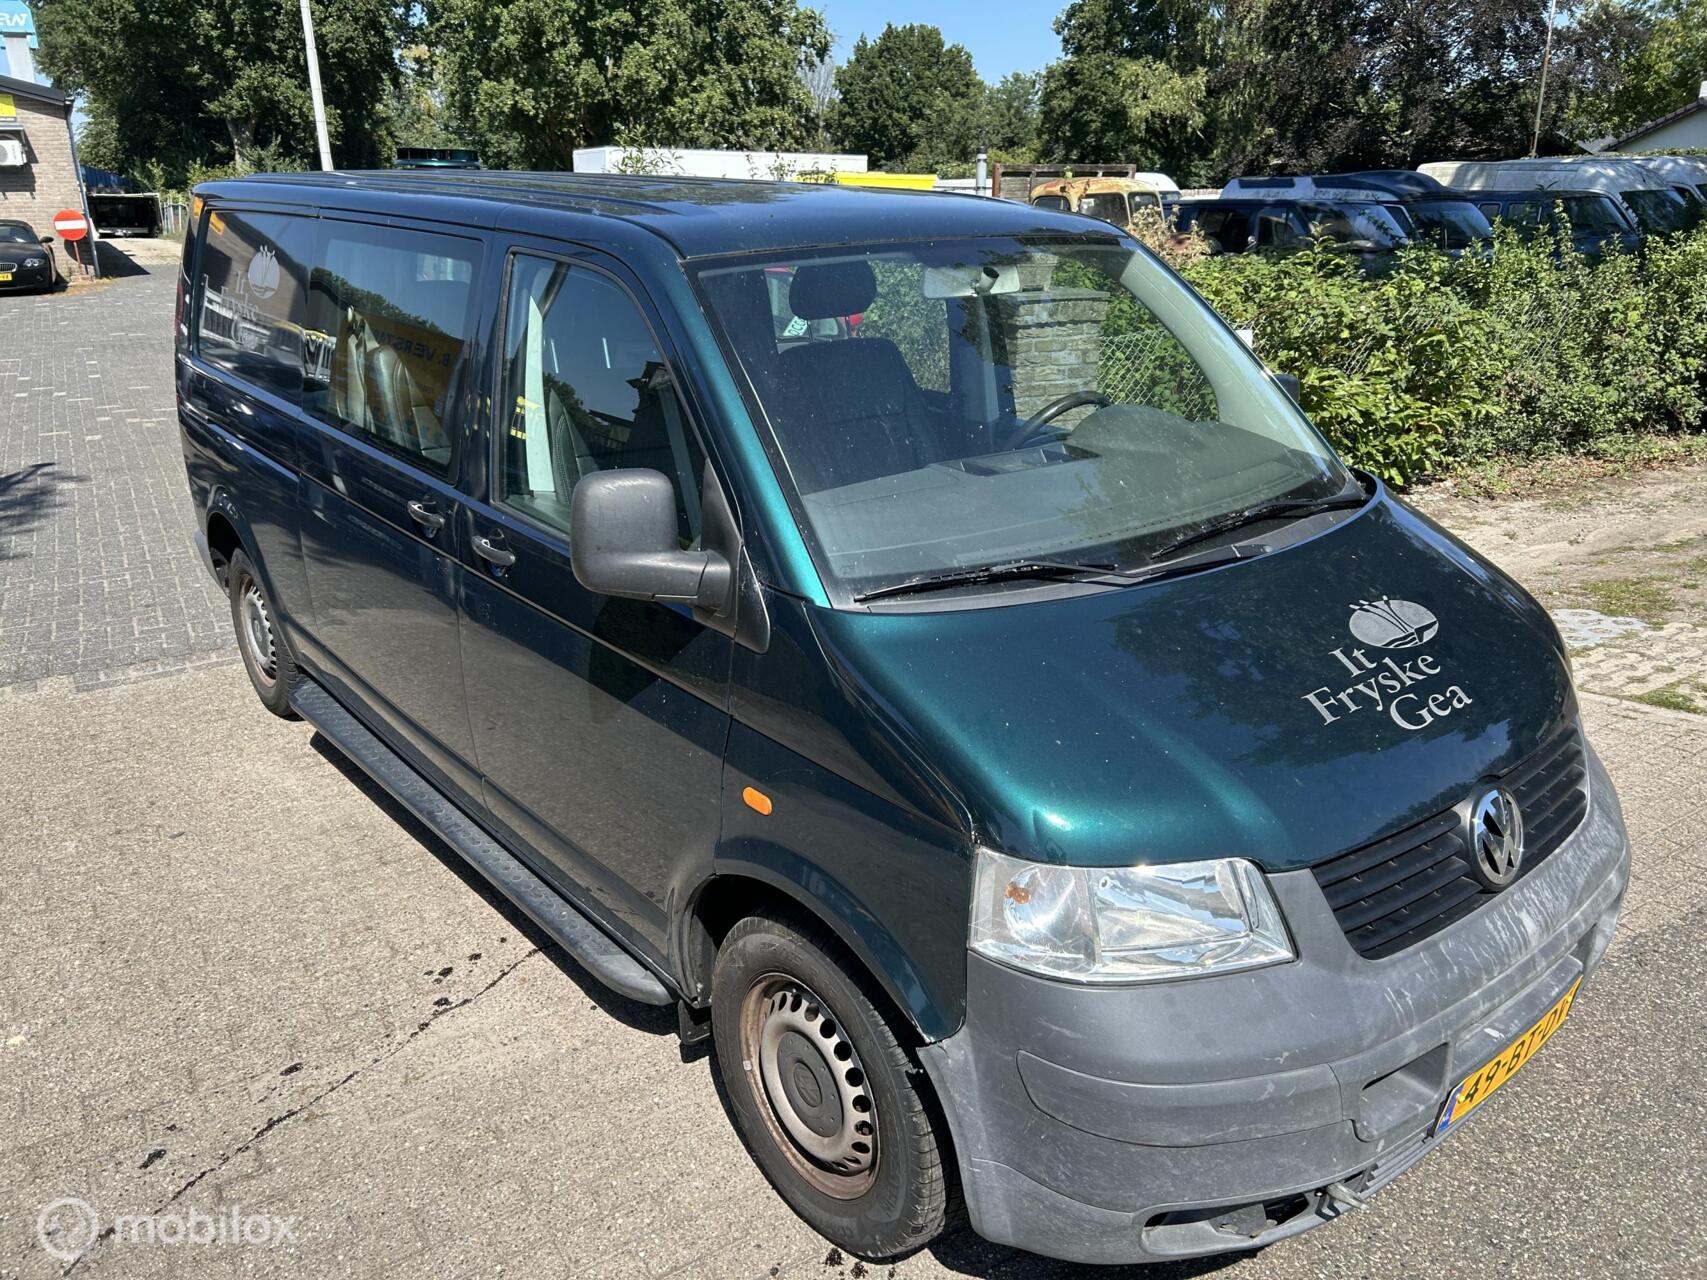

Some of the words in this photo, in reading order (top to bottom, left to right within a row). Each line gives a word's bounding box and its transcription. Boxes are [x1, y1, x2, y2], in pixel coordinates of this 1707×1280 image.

[1301, 655, 1441, 726] Fryske
[1328, 647, 1377, 677] It
[1390, 685, 1473, 730] Gea
[1476, 790, 1522, 883] VW
